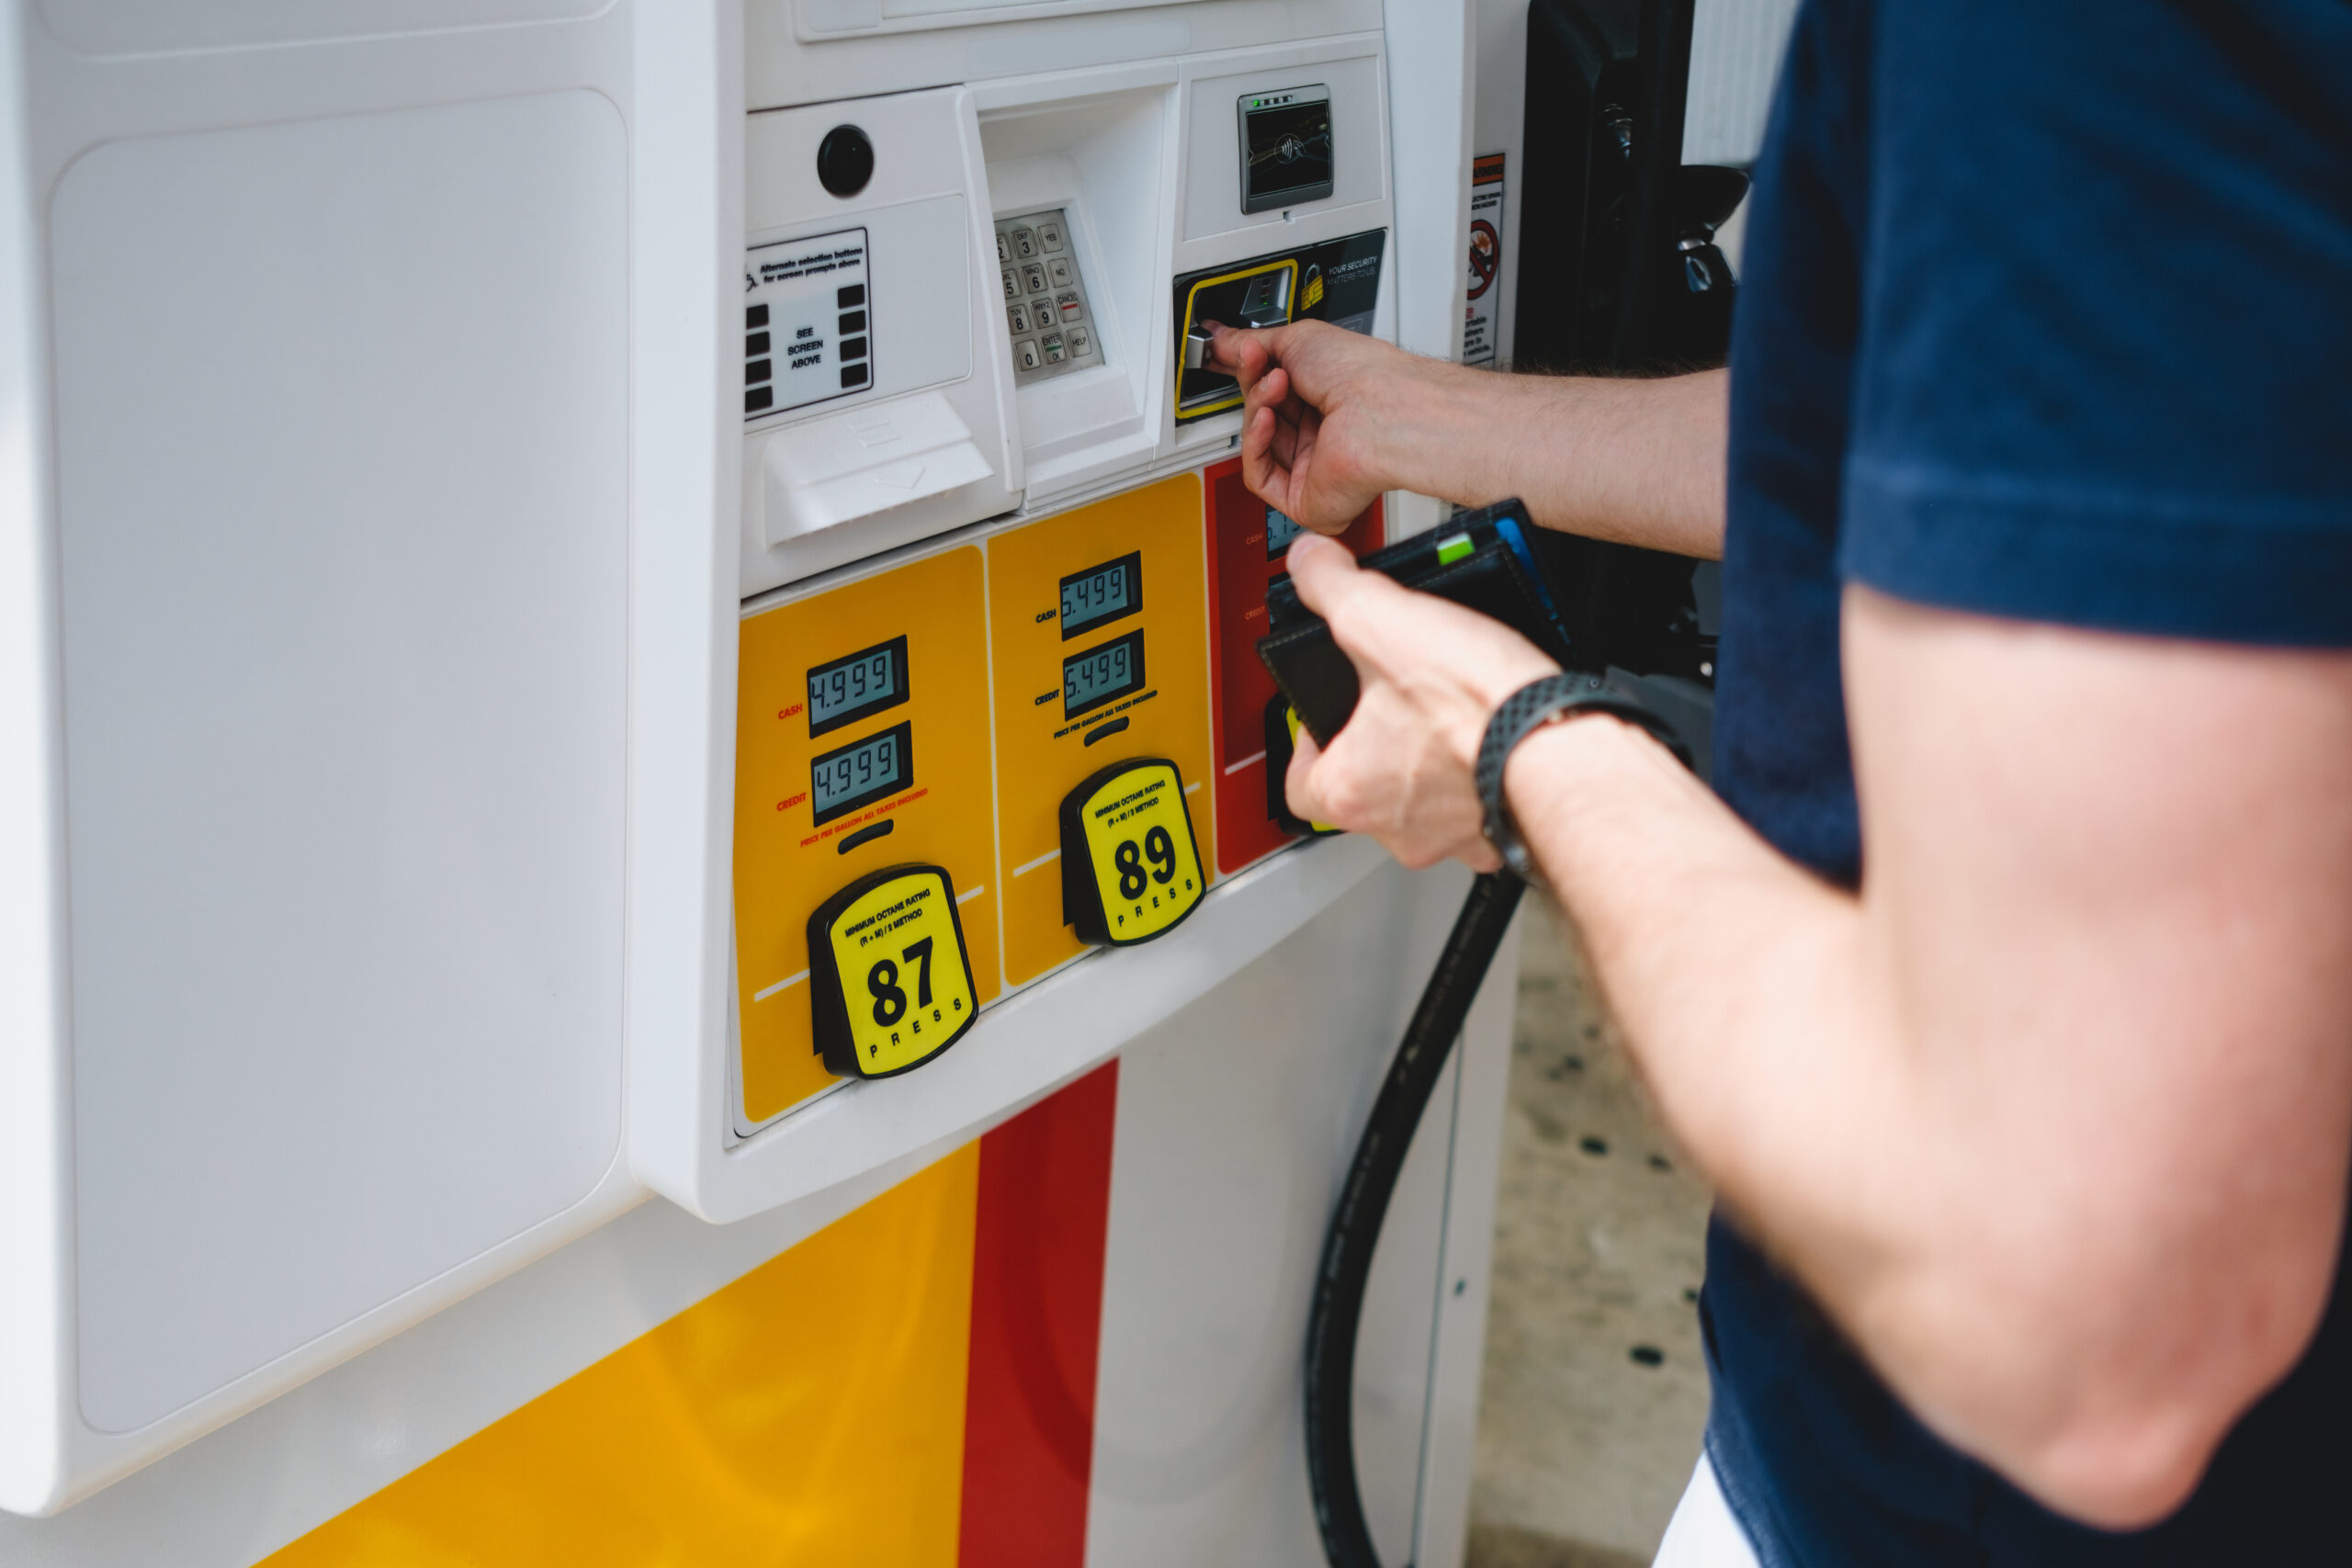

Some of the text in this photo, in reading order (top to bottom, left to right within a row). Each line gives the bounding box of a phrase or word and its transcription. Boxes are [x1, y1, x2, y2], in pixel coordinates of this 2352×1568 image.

[1473, 164, 1504, 178] ARNING
[1045, 233, 1057, 242] YES
[1023, 242, 1030, 254] 3
[760, 248, 863, 274] Alternate selection buttons
[1329, 256, 1378, 275] YOUR SECURITY
[763, 259, 861, 284] for screen prompts above
[1026, 266, 1039, 275] MNO
[1032, 276, 1040, 288] 6
[1327, 272, 1356, 286] MATTERS
[1006, 282, 1013, 294] 5
[1034, 301, 1050, 310] WXYZ
[1057, 293, 1078, 303] CANCEL
[1015, 318, 1023, 330] 8
[1041, 311, 1049, 323] 9
[1464, 316, 1487, 328] ortable
[797, 327, 814, 339] SEE
[1042, 334, 1061, 346] ENTER
[787, 339, 823, 355] SCREEN
[1072, 337, 1087, 346] HELP
[791, 355, 821, 370] ABOVE
[1025, 354, 1034, 366] 0
[1052, 353, 1059, 361] OK
[1245, 532, 1263, 545] CASH
[1035, 608, 1057, 623] CASH
[1244, 604, 1265, 621] CREDIT
[1066, 647, 1126, 699] 5.499
[811, 655, 887, 710] 4.999
[1035, 689, 1059, 705] CREDIT
[778, 703, 803, 719] CASH
[1054, 690, 1158, 739] PRICE PER GALLON ALL TAXES INCLUDED
[817, 741, 891, 797] 4.999
[776, 792, 807, 812] CREDIT
[1095, 779, 1166, 818] MINIMUM OCTANE RATING
[1130, 808, 1135, 817] 2
[1135, 796, 1159, 814] METHOD
[799, 788, 929, 848] PRICE PER GALLON ALL TAXES INCLUDED
[1114, 825, 1176, 900] 89
[1117, 878, 1193, 927] PRESS
[845, 888, 931, 938] MINIMUM OCTANE RATING
[860, 936, 868, 948] (R
[874, 928, 884, 938] M)
[888, 923, 893, 931] 2
[893, 908, 923, 929] METHOD
[867, 935, 933, 1027] 87
[869, 998, 962, 1058] PRESS
